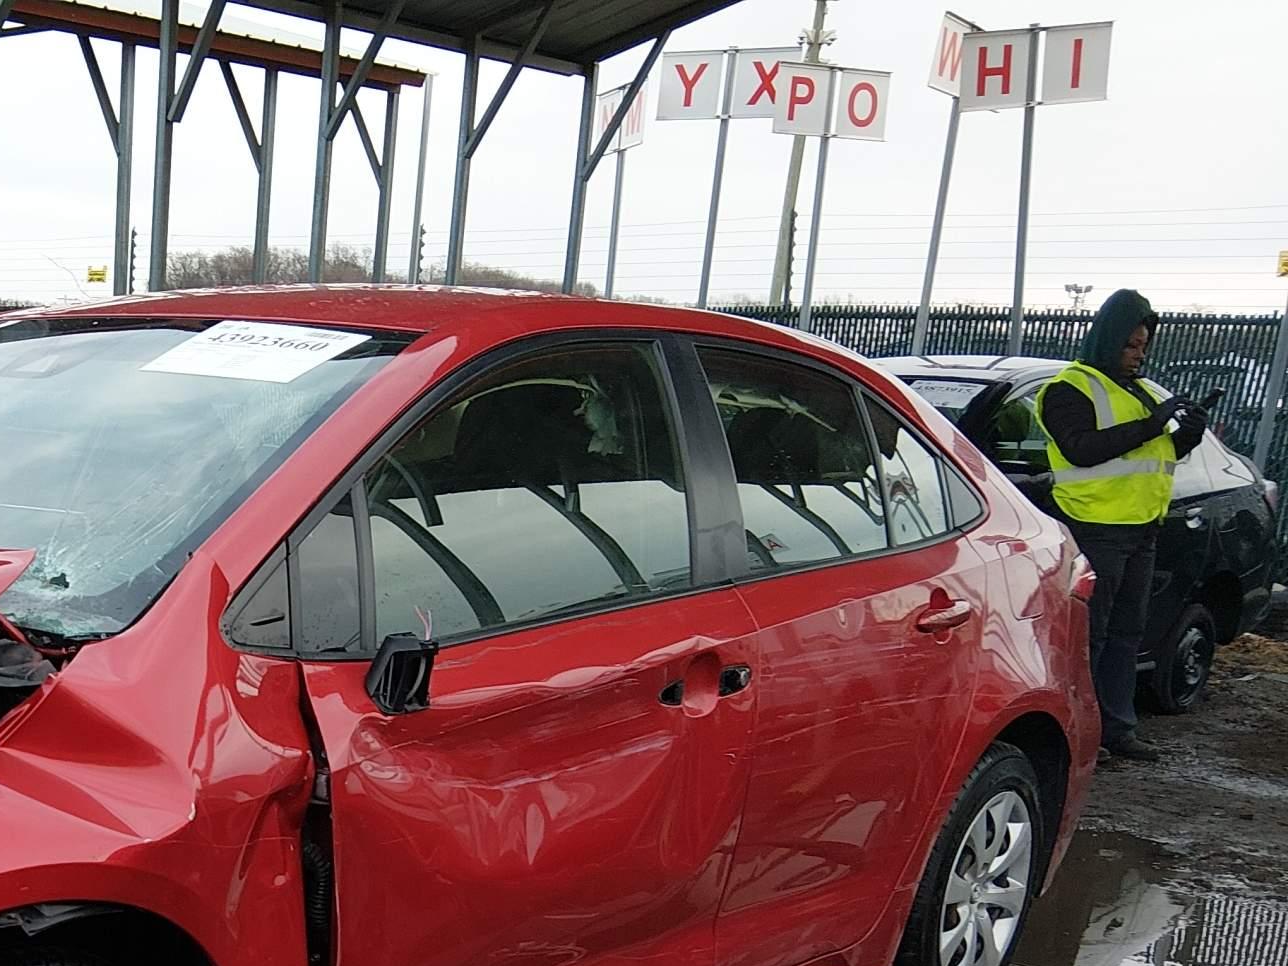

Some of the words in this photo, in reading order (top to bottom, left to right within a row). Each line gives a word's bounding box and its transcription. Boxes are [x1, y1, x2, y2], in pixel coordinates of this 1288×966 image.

[675, 63, 709, 108] Y
[747, 60, 780, 106] X
[976, 44, 1012, 97] H
[1070, 38, 1085, 89] I
[786, 75, 816, 122] P
[847, 81, 879, 128] O
[208, 332, 331, 352] 43923660
